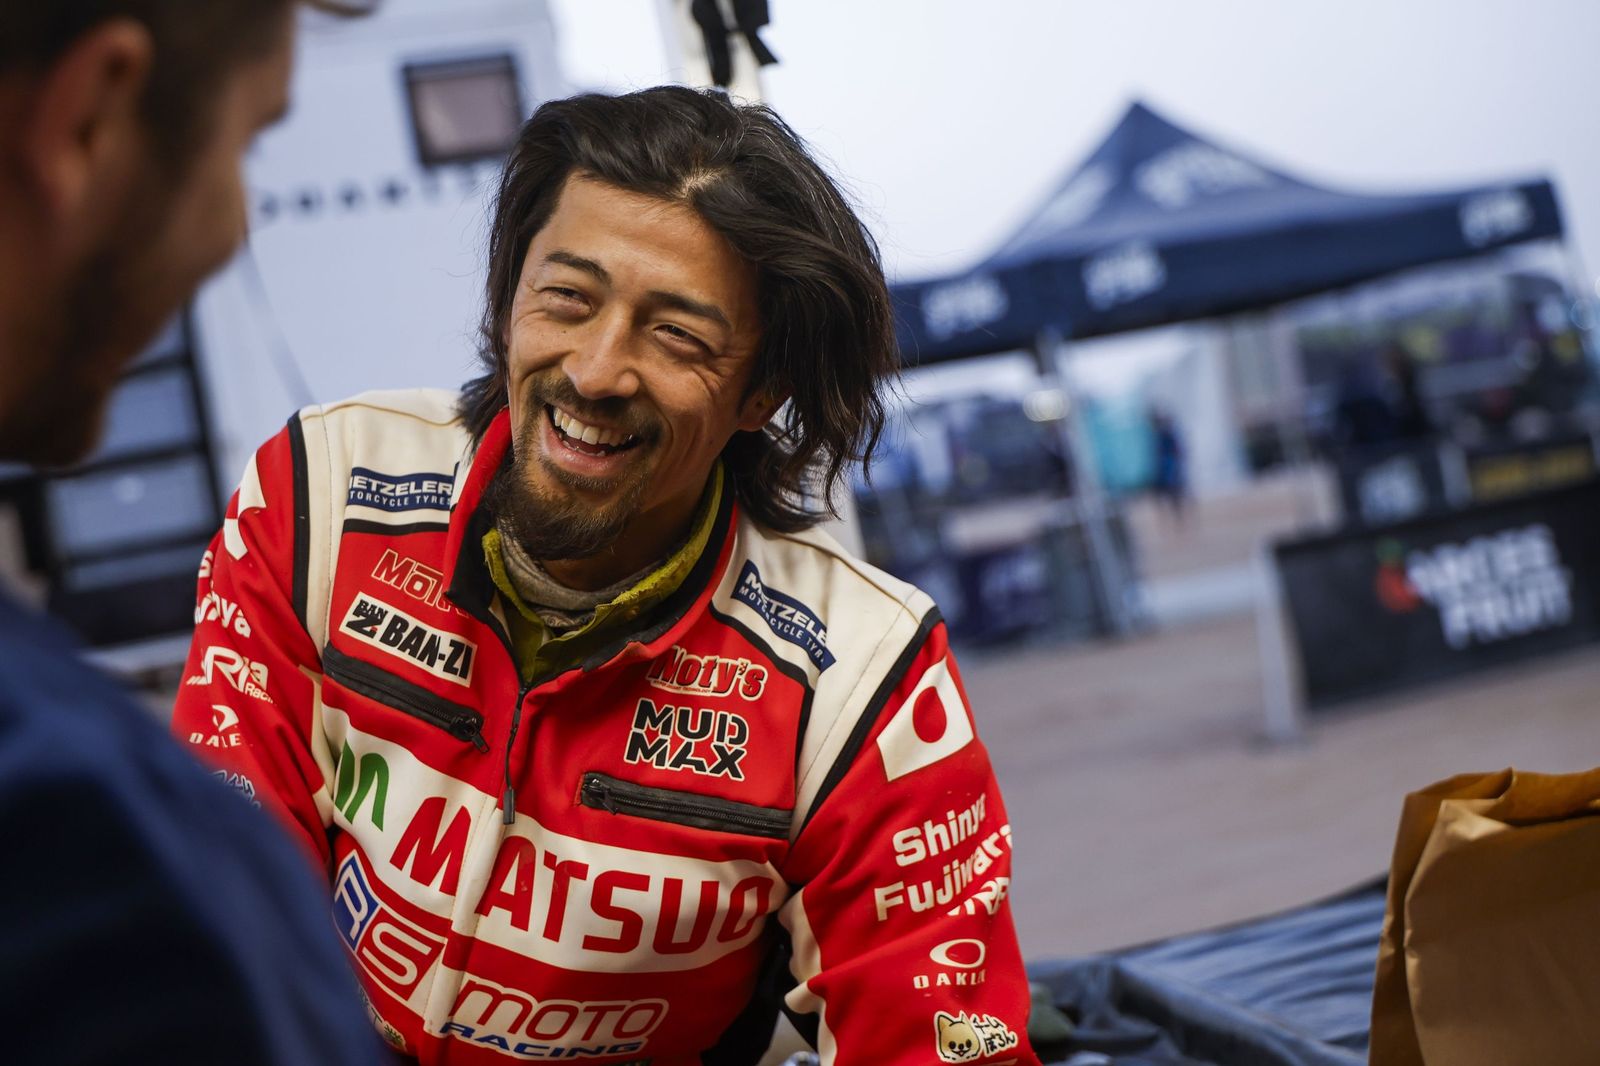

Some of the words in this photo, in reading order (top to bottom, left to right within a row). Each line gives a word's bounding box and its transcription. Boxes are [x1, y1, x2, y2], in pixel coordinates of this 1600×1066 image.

[350, 490, 409, 507] TORCYCLE
[379, 614, 473, 680] BAN-ZI
[647, 646, 767, 700] Noty's
[632, 698, 748, 746] MUD
[624, 730, 747, 782] MAX
[389, 796, 774, 955] MATSUO
[439, 1021, 642, 1058] RACING
